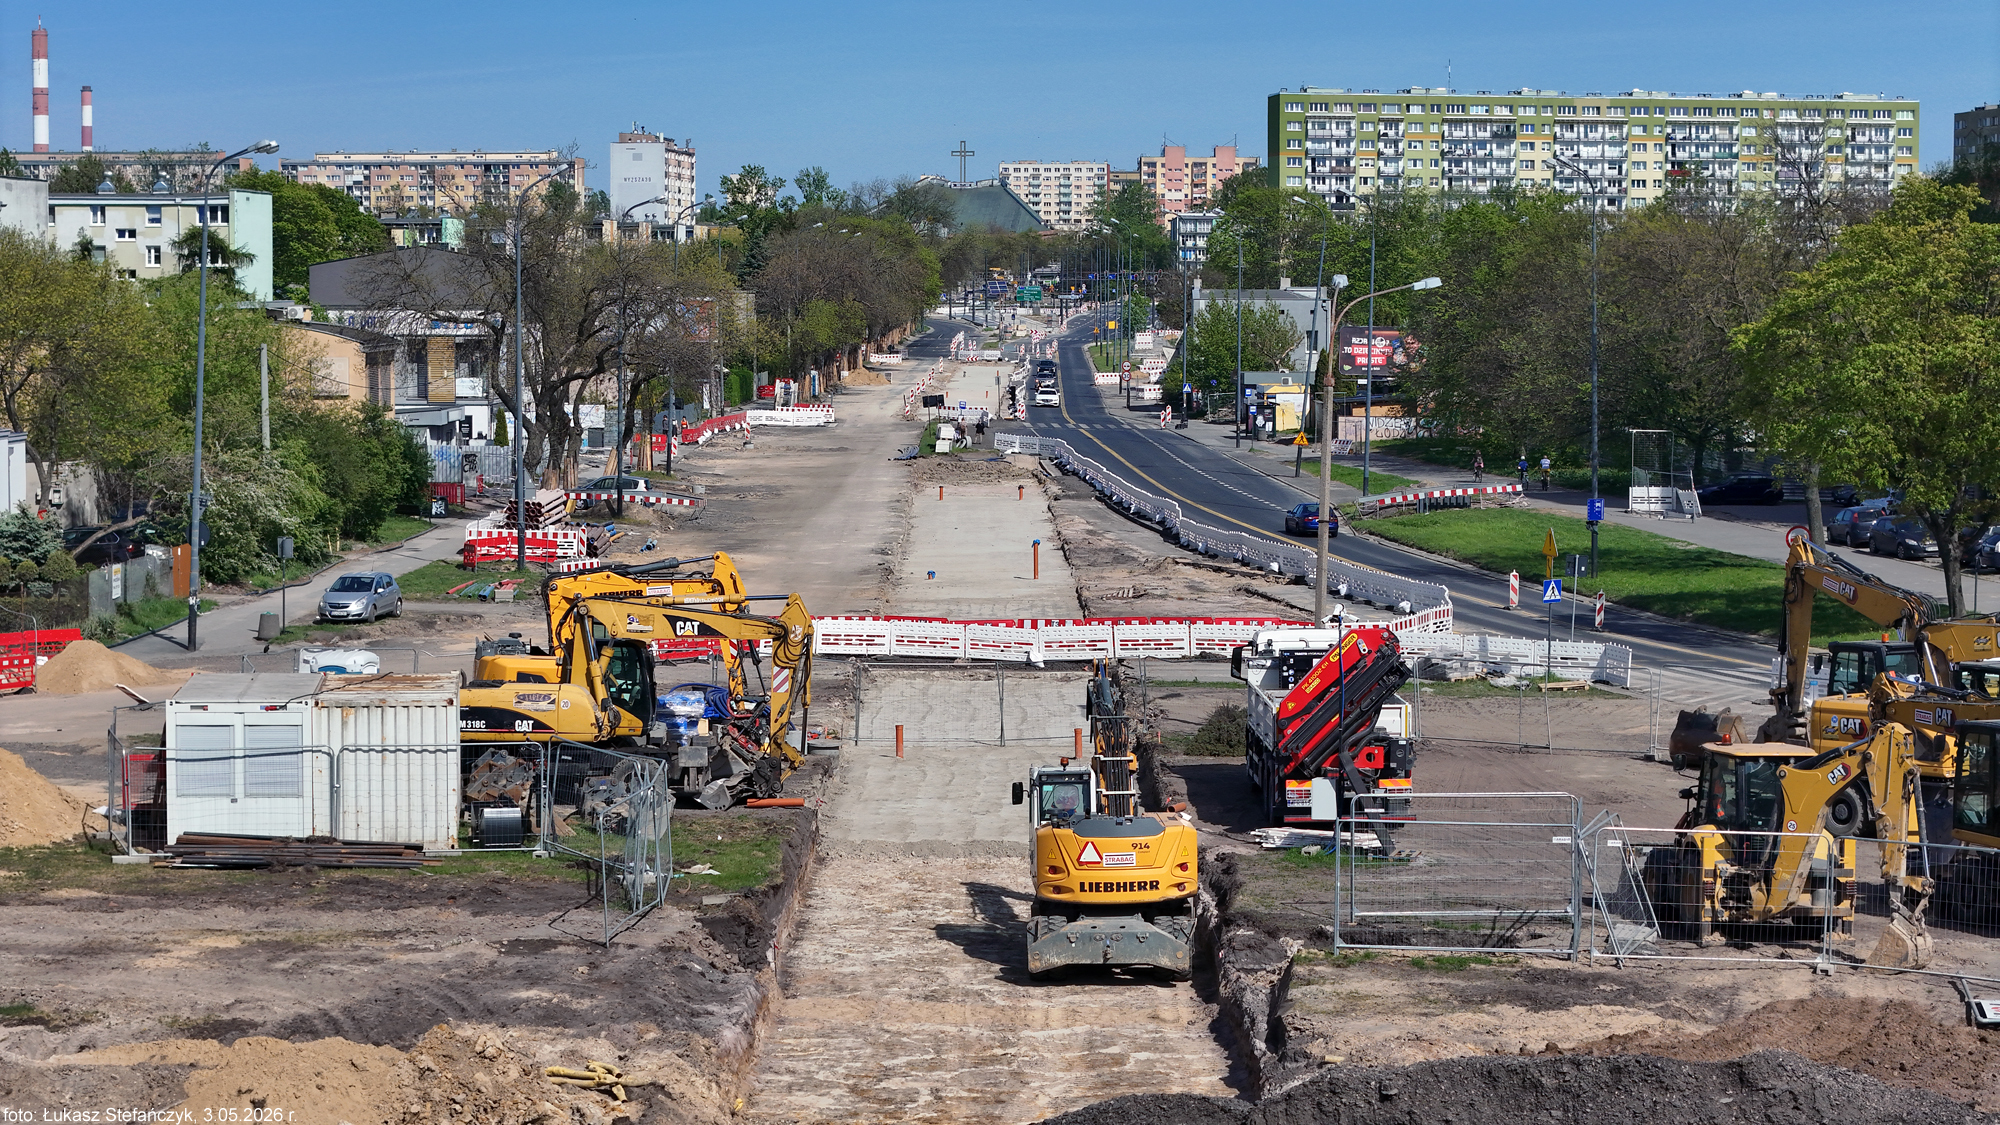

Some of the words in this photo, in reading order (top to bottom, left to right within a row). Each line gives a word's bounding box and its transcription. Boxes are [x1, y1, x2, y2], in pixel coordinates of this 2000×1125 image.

[1840, 581, 1855, 600] CAT
[676, 620, 700, 636] CAT
[1331, 634, 1357, 660] PALINGER
[1935, 707, 1953, 727] CAT
[514, 720, 534, 732] CAT
[1840, 718, 1862, 735] CAT
[1827, 763, 1847, 785] CAT
[1131, 842, 1150, 850] 914
[1079, 880, 1160, 893] LIEBHERR
